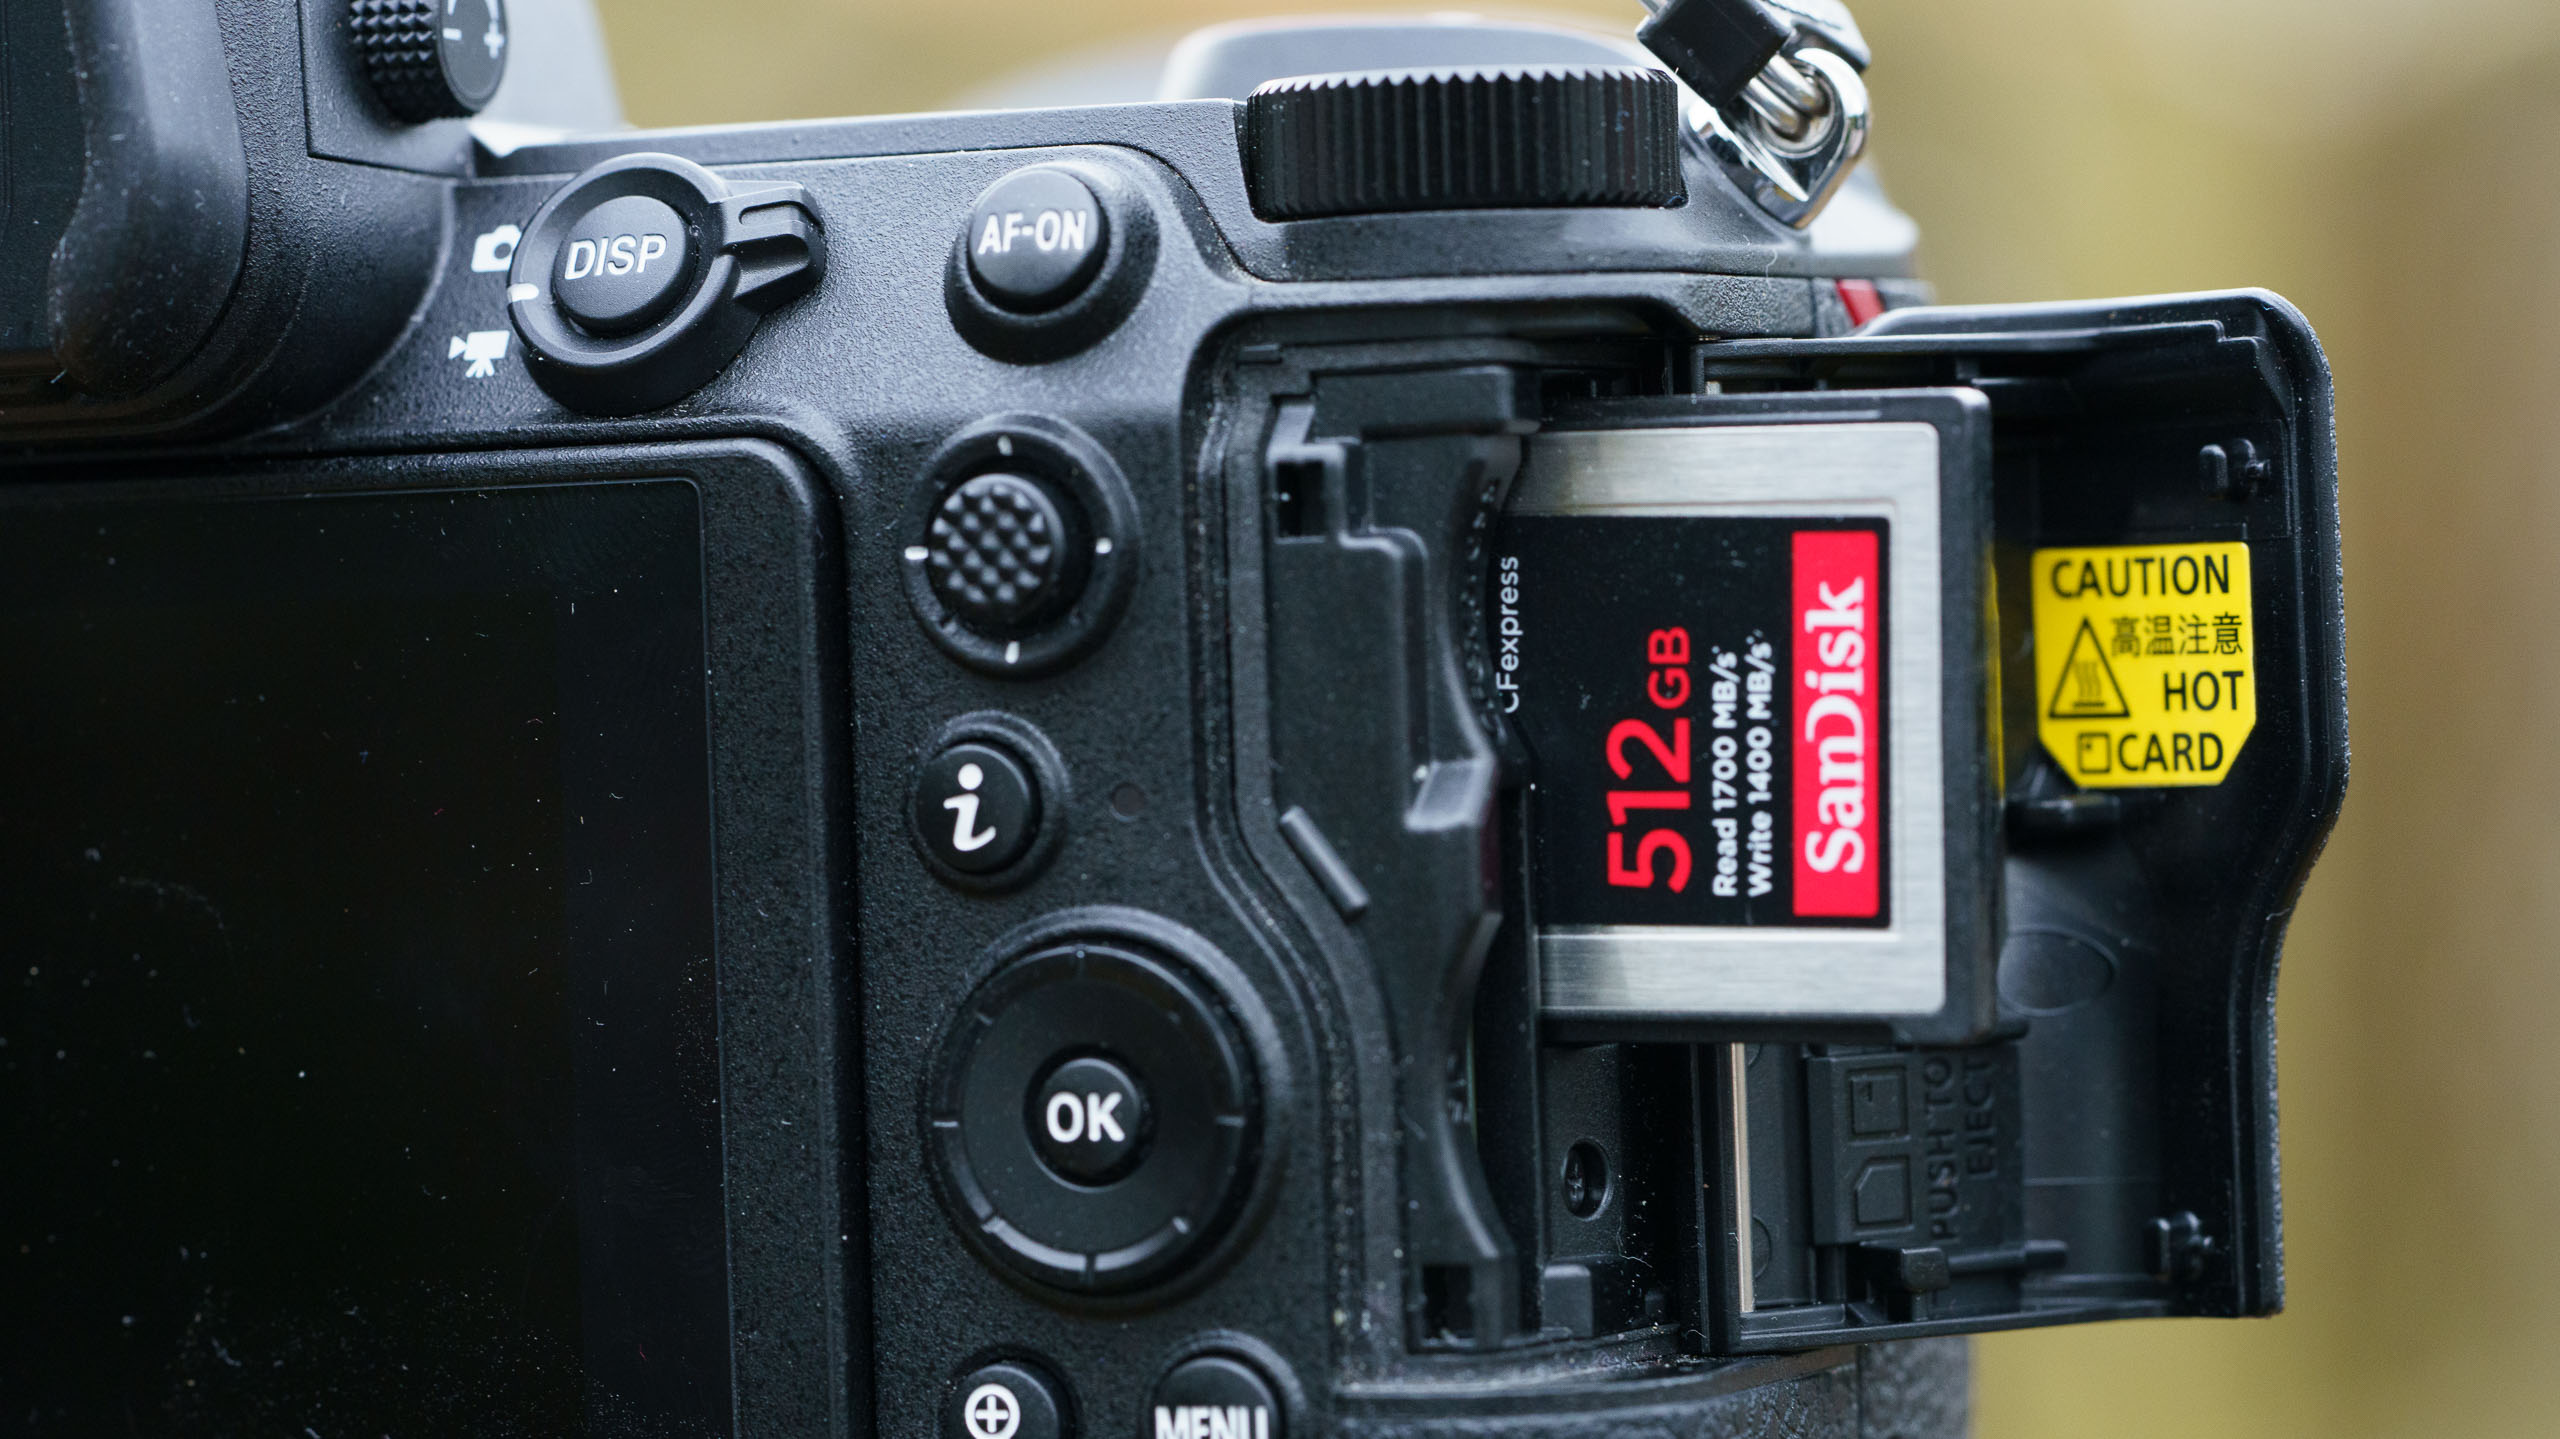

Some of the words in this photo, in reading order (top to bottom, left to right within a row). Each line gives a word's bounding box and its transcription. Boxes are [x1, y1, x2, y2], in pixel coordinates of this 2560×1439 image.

[564, 233, 668, 280] DISP
[977, 210, 1088, 256] AF-ON
[2051, 554, 2230, 599] CAUTION
[1647, 627, 1691, 709] GB
[2110, 611, 2244, 658] 高温注意
[1804, 577, 1865, 873] SanDisk
[2163, 670, 2244, 712] HOT
[1712, 735, 1738, 811] 1700
[1746, 726, 1773, 804] 1400
[2117, 732, 2224, 773] CARD
[1606, 719, 1692, 893] 512
[1712, 818, 1738, 897] Read
[1747, 811, 1773, 897] Write
[1046, 1092, 1125, 1143] OK
[1923, 1055, 1953, 1117] TO
[1962, 1054, 1995, 1177] EJECT
[1927, 1127, 1957, 1240] PUSH
[1154, 1405, 1269, 1439] MENU
